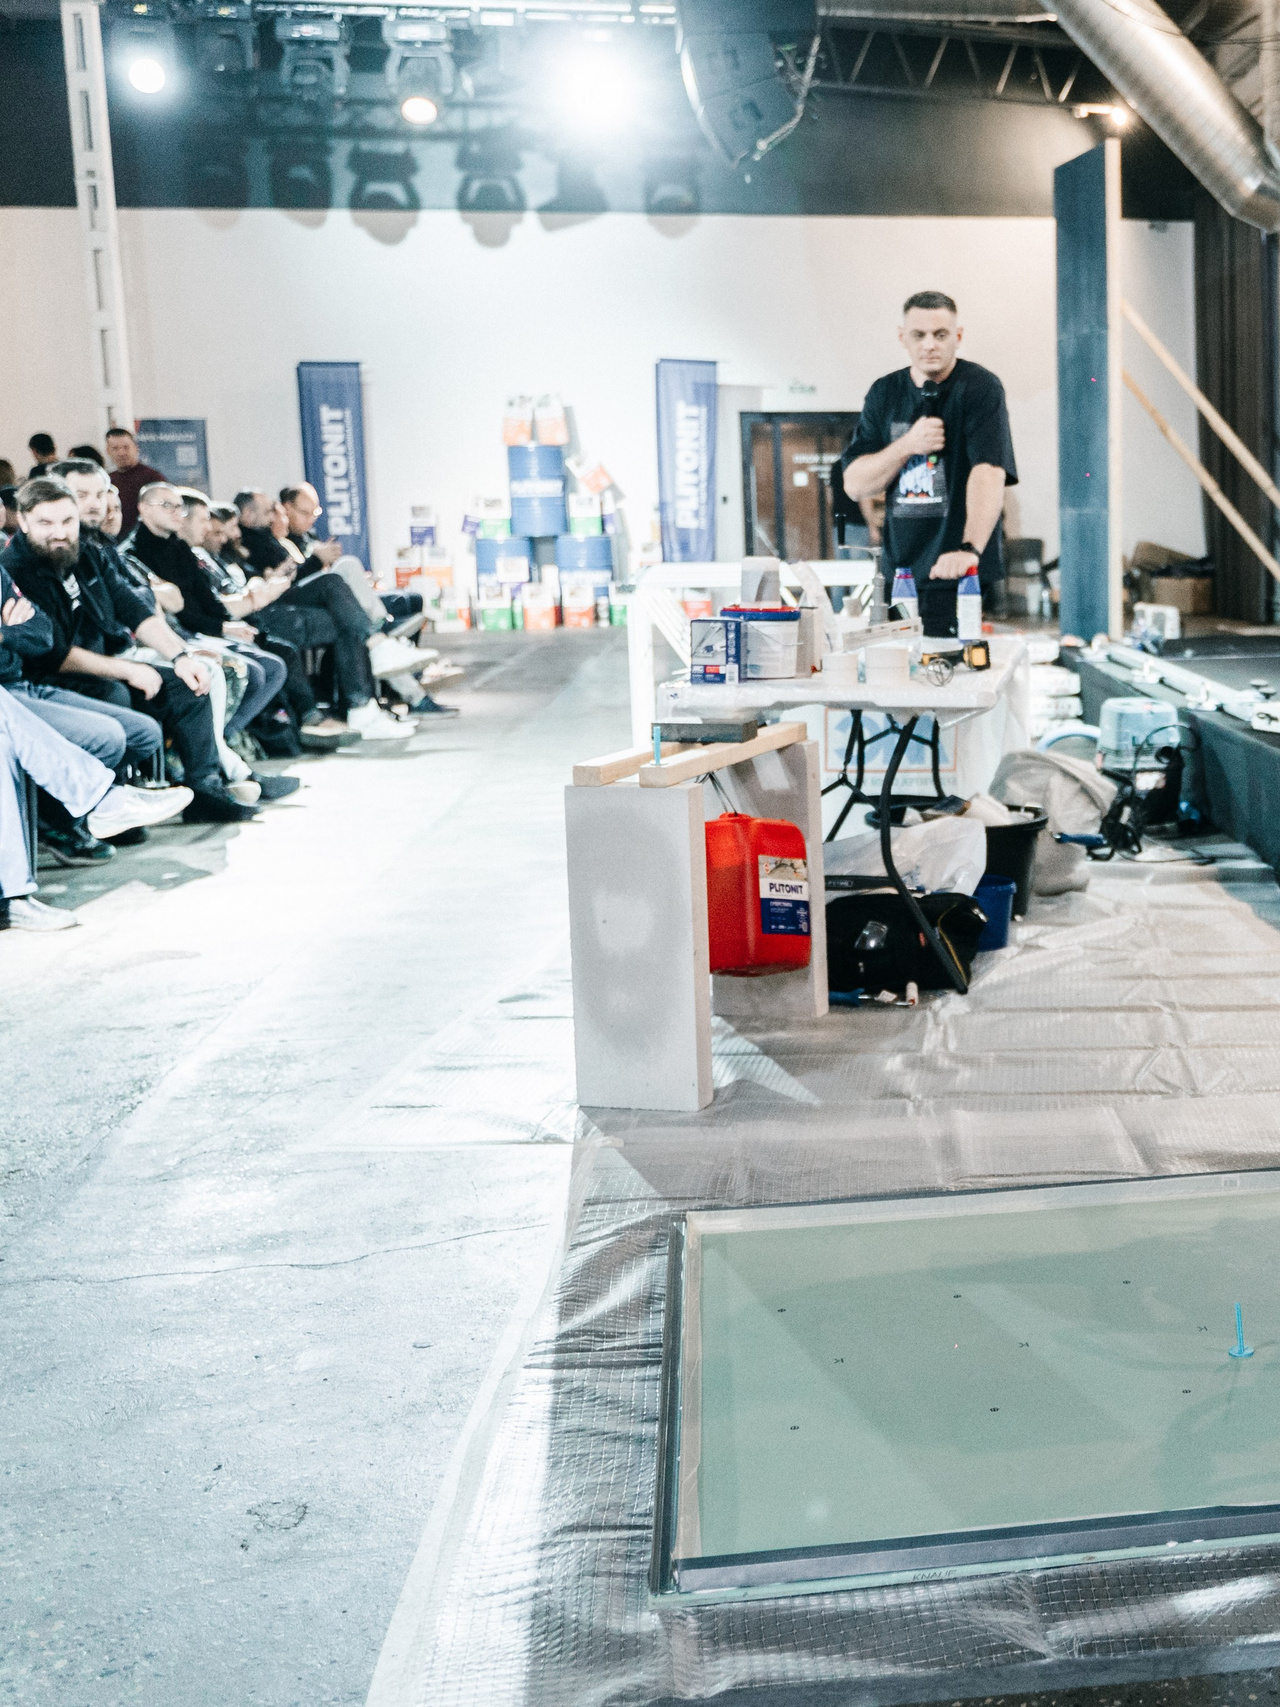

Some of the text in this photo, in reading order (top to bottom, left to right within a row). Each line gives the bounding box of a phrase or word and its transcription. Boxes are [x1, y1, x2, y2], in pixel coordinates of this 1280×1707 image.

[319, 403, 353, 536] PLITONIT
[675, 399, 700, 529] PLITONIT
[769, 883, 803, 895] PLITONIT
